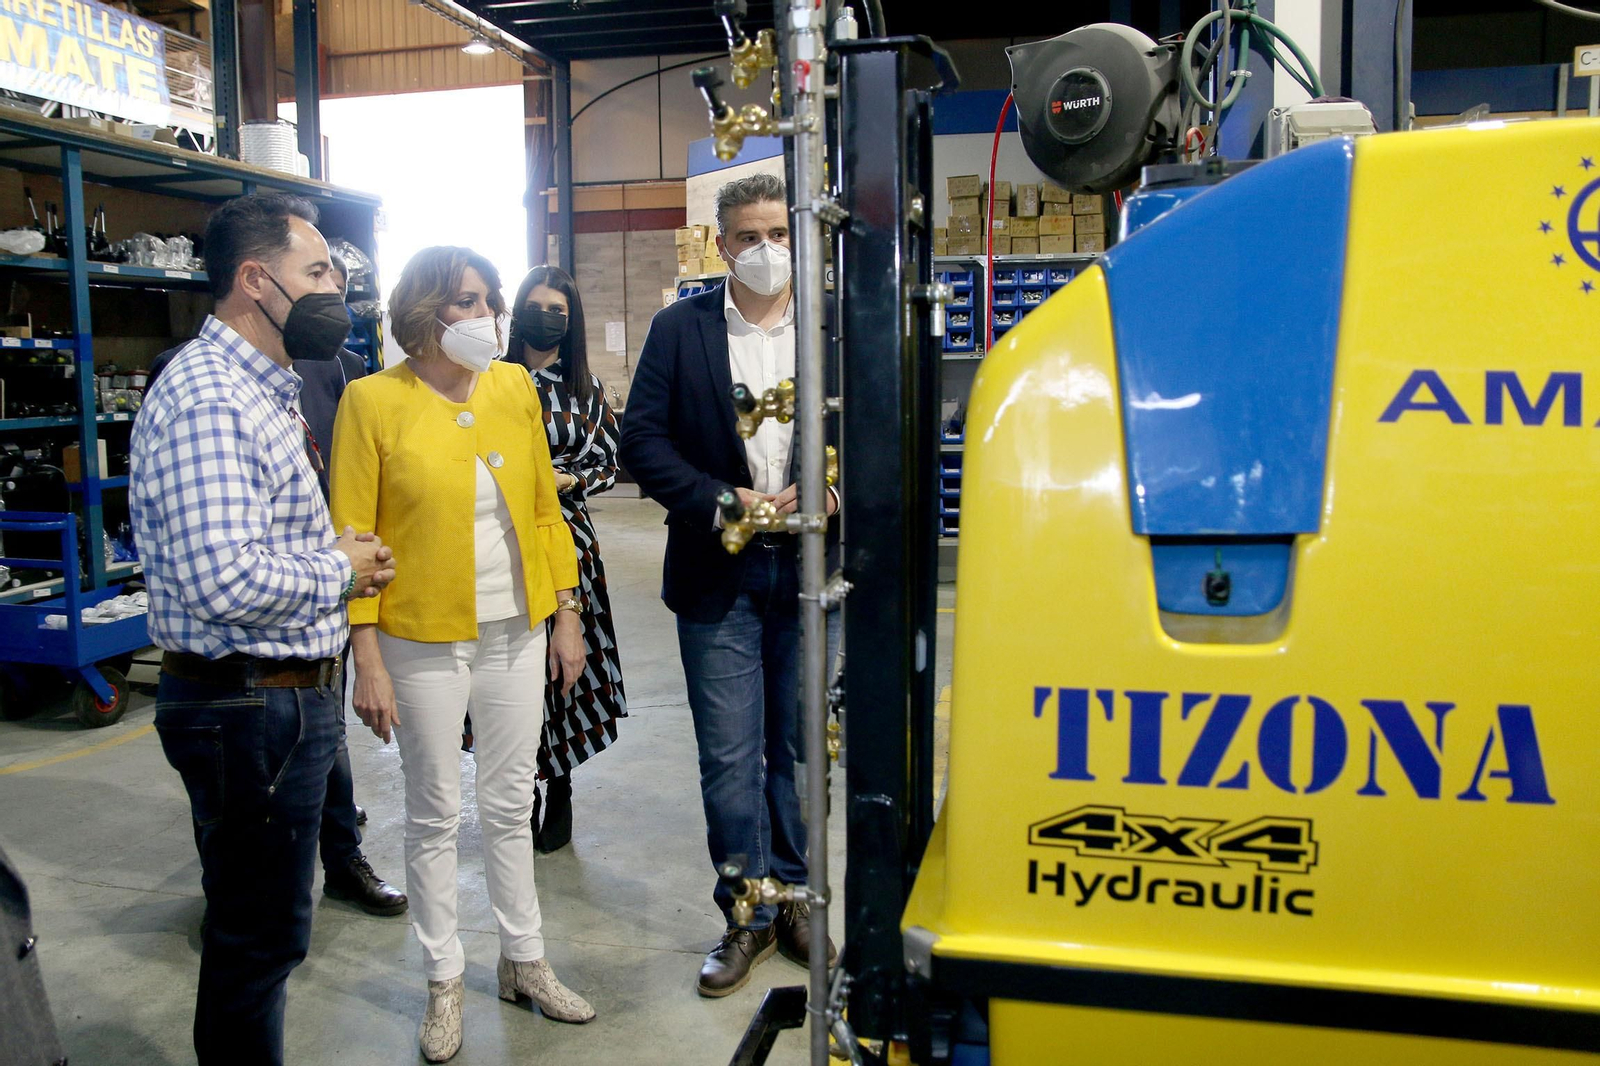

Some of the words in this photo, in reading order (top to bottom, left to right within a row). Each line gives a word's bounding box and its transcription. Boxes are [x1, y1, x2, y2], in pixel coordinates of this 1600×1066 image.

[1580, 51, 1600, 66] C-
[1063, 96, 1100, 111] WÜRTH
[1377, 369, 1600, 428] AM
[1033, 686, 1556, 806] TIZONA
[1027, 859, 1315, 917] Hydraulic
